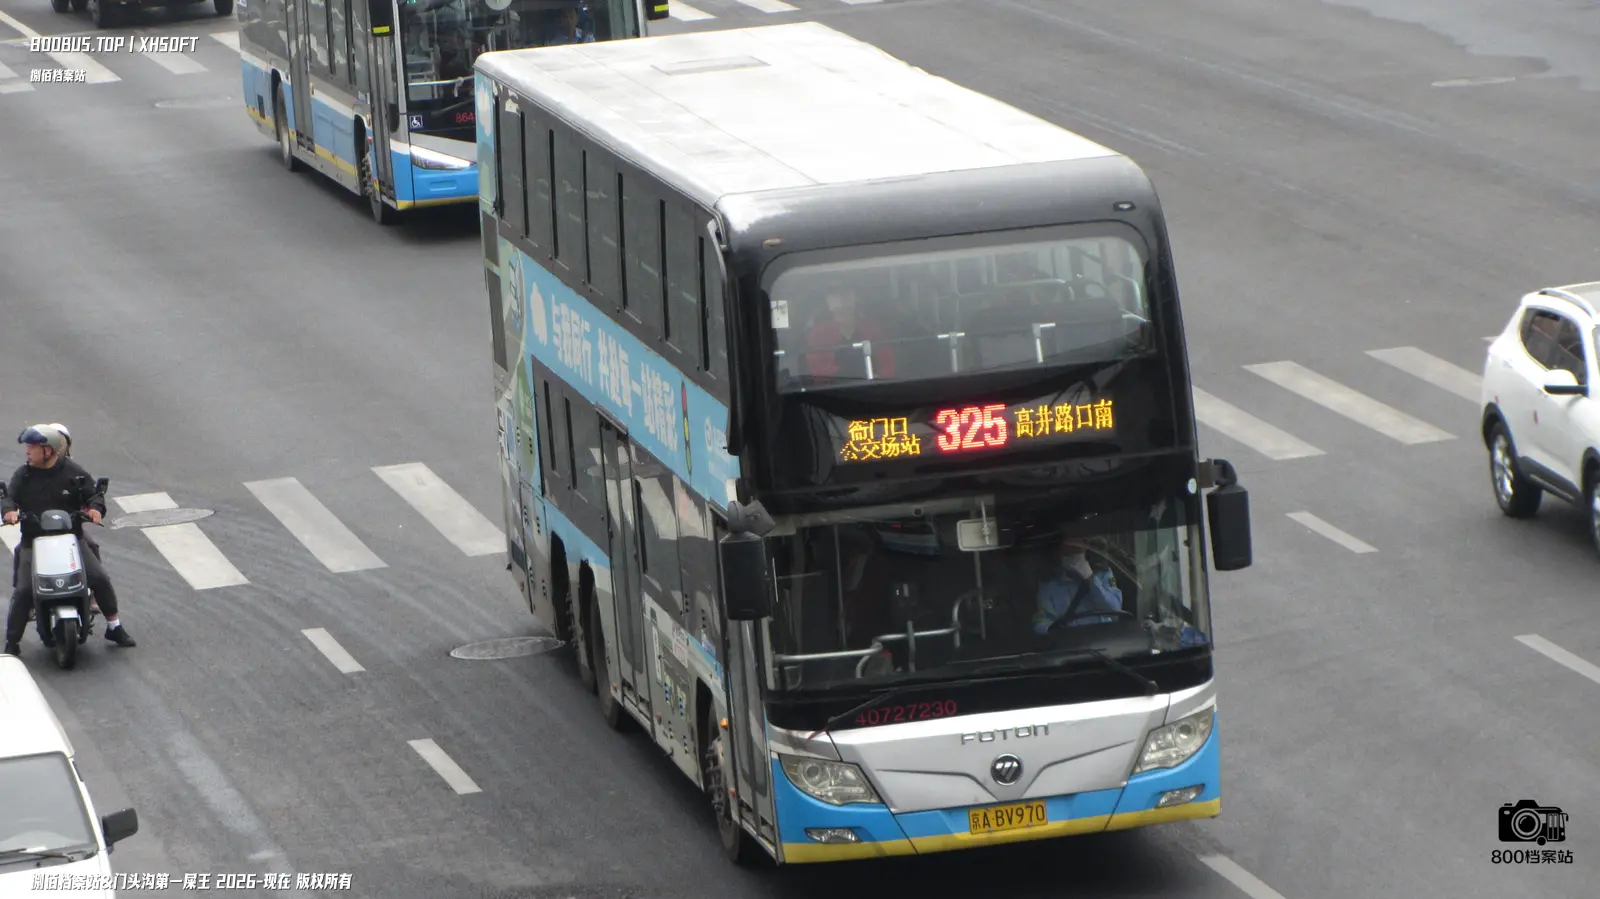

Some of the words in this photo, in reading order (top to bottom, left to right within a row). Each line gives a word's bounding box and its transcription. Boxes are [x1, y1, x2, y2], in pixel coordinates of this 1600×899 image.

[848, 417, 908, 441] 衙门口
[936, 403, 1008, 452] 325
[1014, 399, 1113, 438] 高井路口南
[840, 434, 921, 461] 公交场站
[855, 700, 958, 726] 40727230
[961, 723, 1050, 745] FOTON
